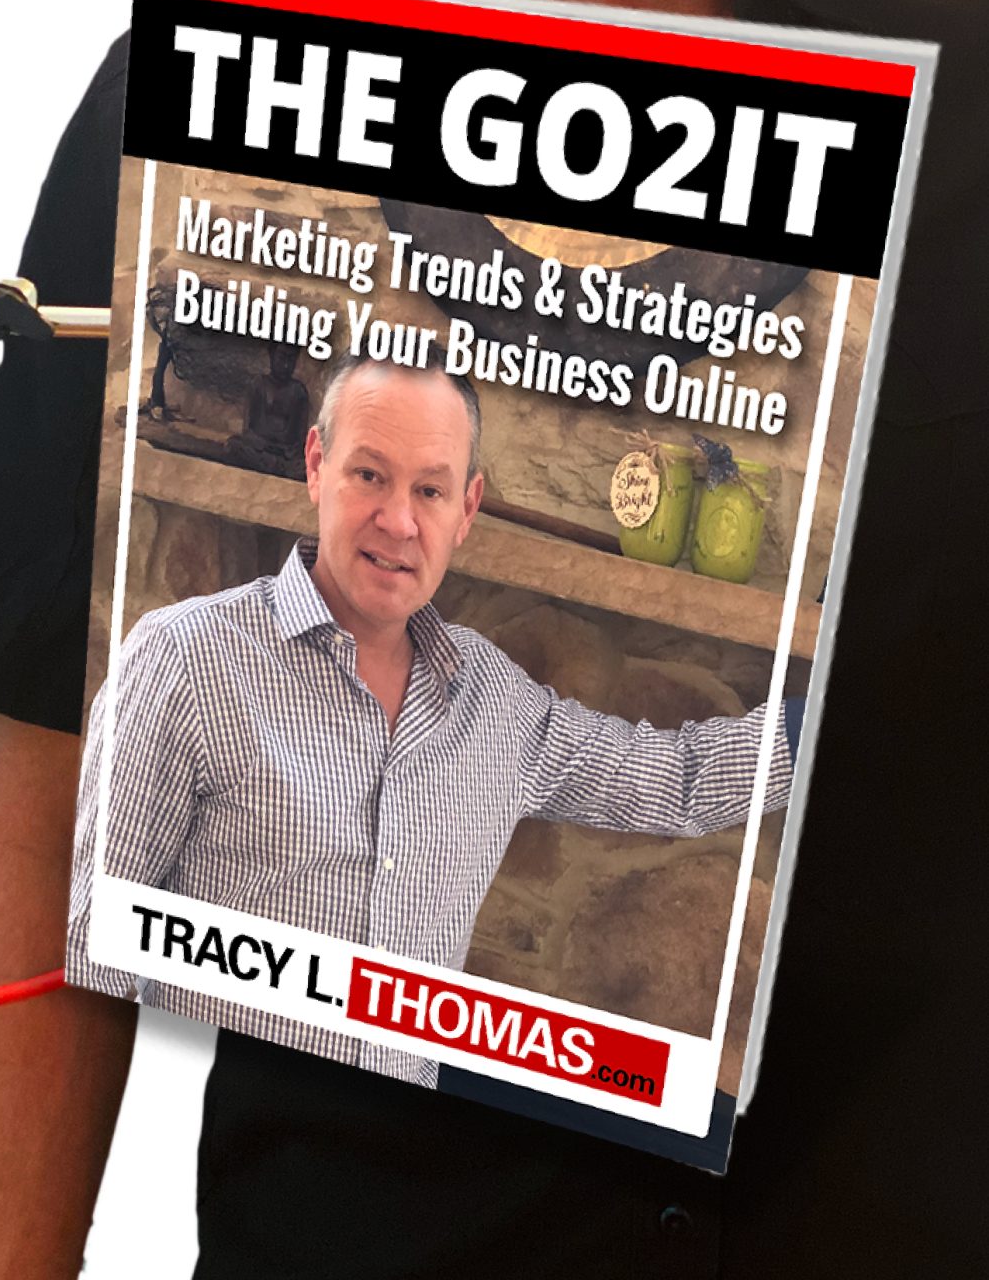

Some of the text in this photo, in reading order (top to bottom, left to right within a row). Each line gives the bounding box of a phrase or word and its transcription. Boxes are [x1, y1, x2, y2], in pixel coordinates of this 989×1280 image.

[173, 25, 857, 237] THE GO2IT
[174, 270, 787, 435] Building Your Business Online
[176, 197, 805, 361] Marketing Trends & Strategies
[132, 905, 295, 990] TRACY
[307, 955, 345, 1008] L.
